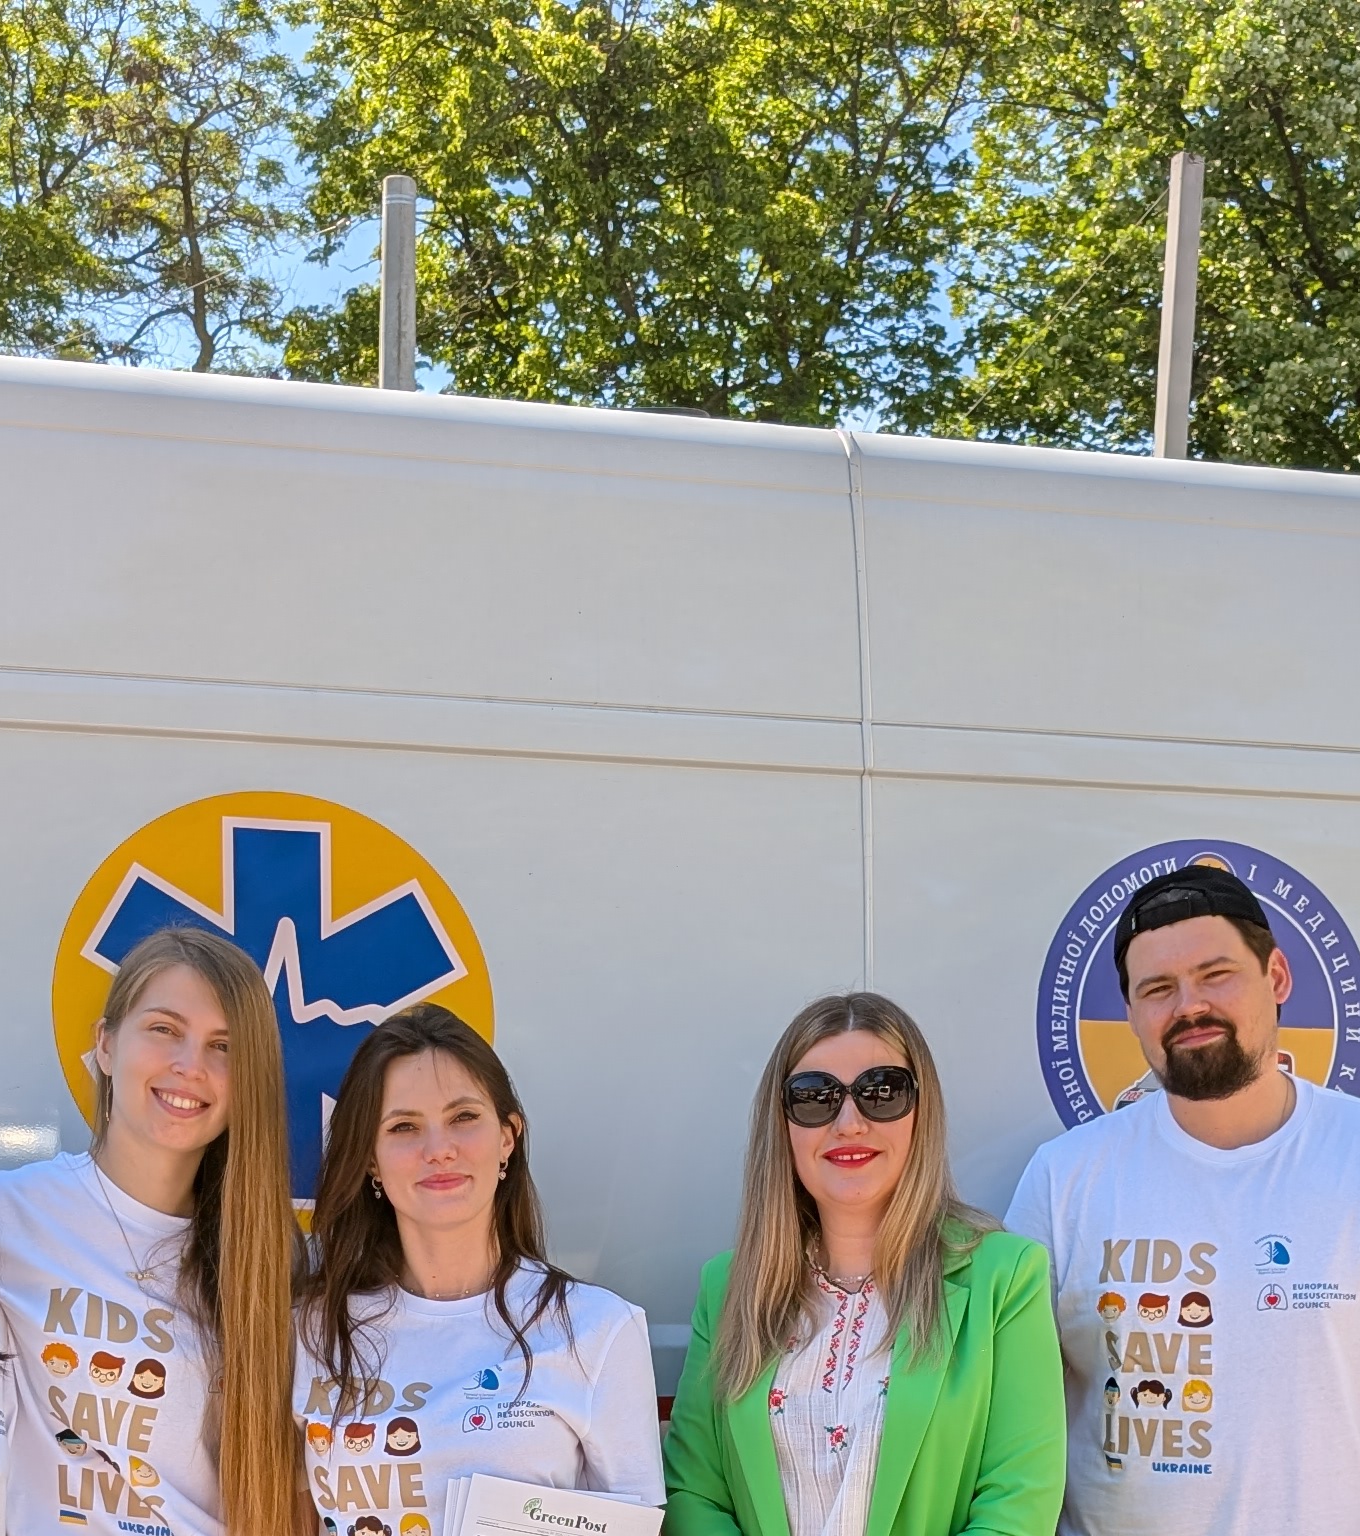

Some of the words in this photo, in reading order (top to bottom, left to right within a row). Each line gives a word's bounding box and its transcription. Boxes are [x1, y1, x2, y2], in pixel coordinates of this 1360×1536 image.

[1078, 857, 1178, 939] ДОПОМОГИ
[1051, 930, 1087, 1053] МЕДИЧНОЇ
[1051, 1057, 1094, 1124] РЕНОЇ
[1099, 1239, 1219, 1286] KIDS
[1292, 1283, 1339, 1291] EUROPEAN
[1292, 1292, 1357, 1301] RESUSCITATION
[1292, 1302, 1332, 1310] COUNCIL
[43, 1287, 176, 1354] KIDS
[1104, 1330, 1214, 1376] SAVE
[303, 1376, 434, 1416] KIDS
[48, 1385, 159, 1453] SAVE
[497, 1420, 535, 1429] COUNCIL
[1103, 1413, 1213, 1458] LIVES
[314, 1462, 428, 1513] SAVE
[1152, 1462, 1213, 1475] UKRAINE
[529, 1507, 608, 1535] GreenPost
